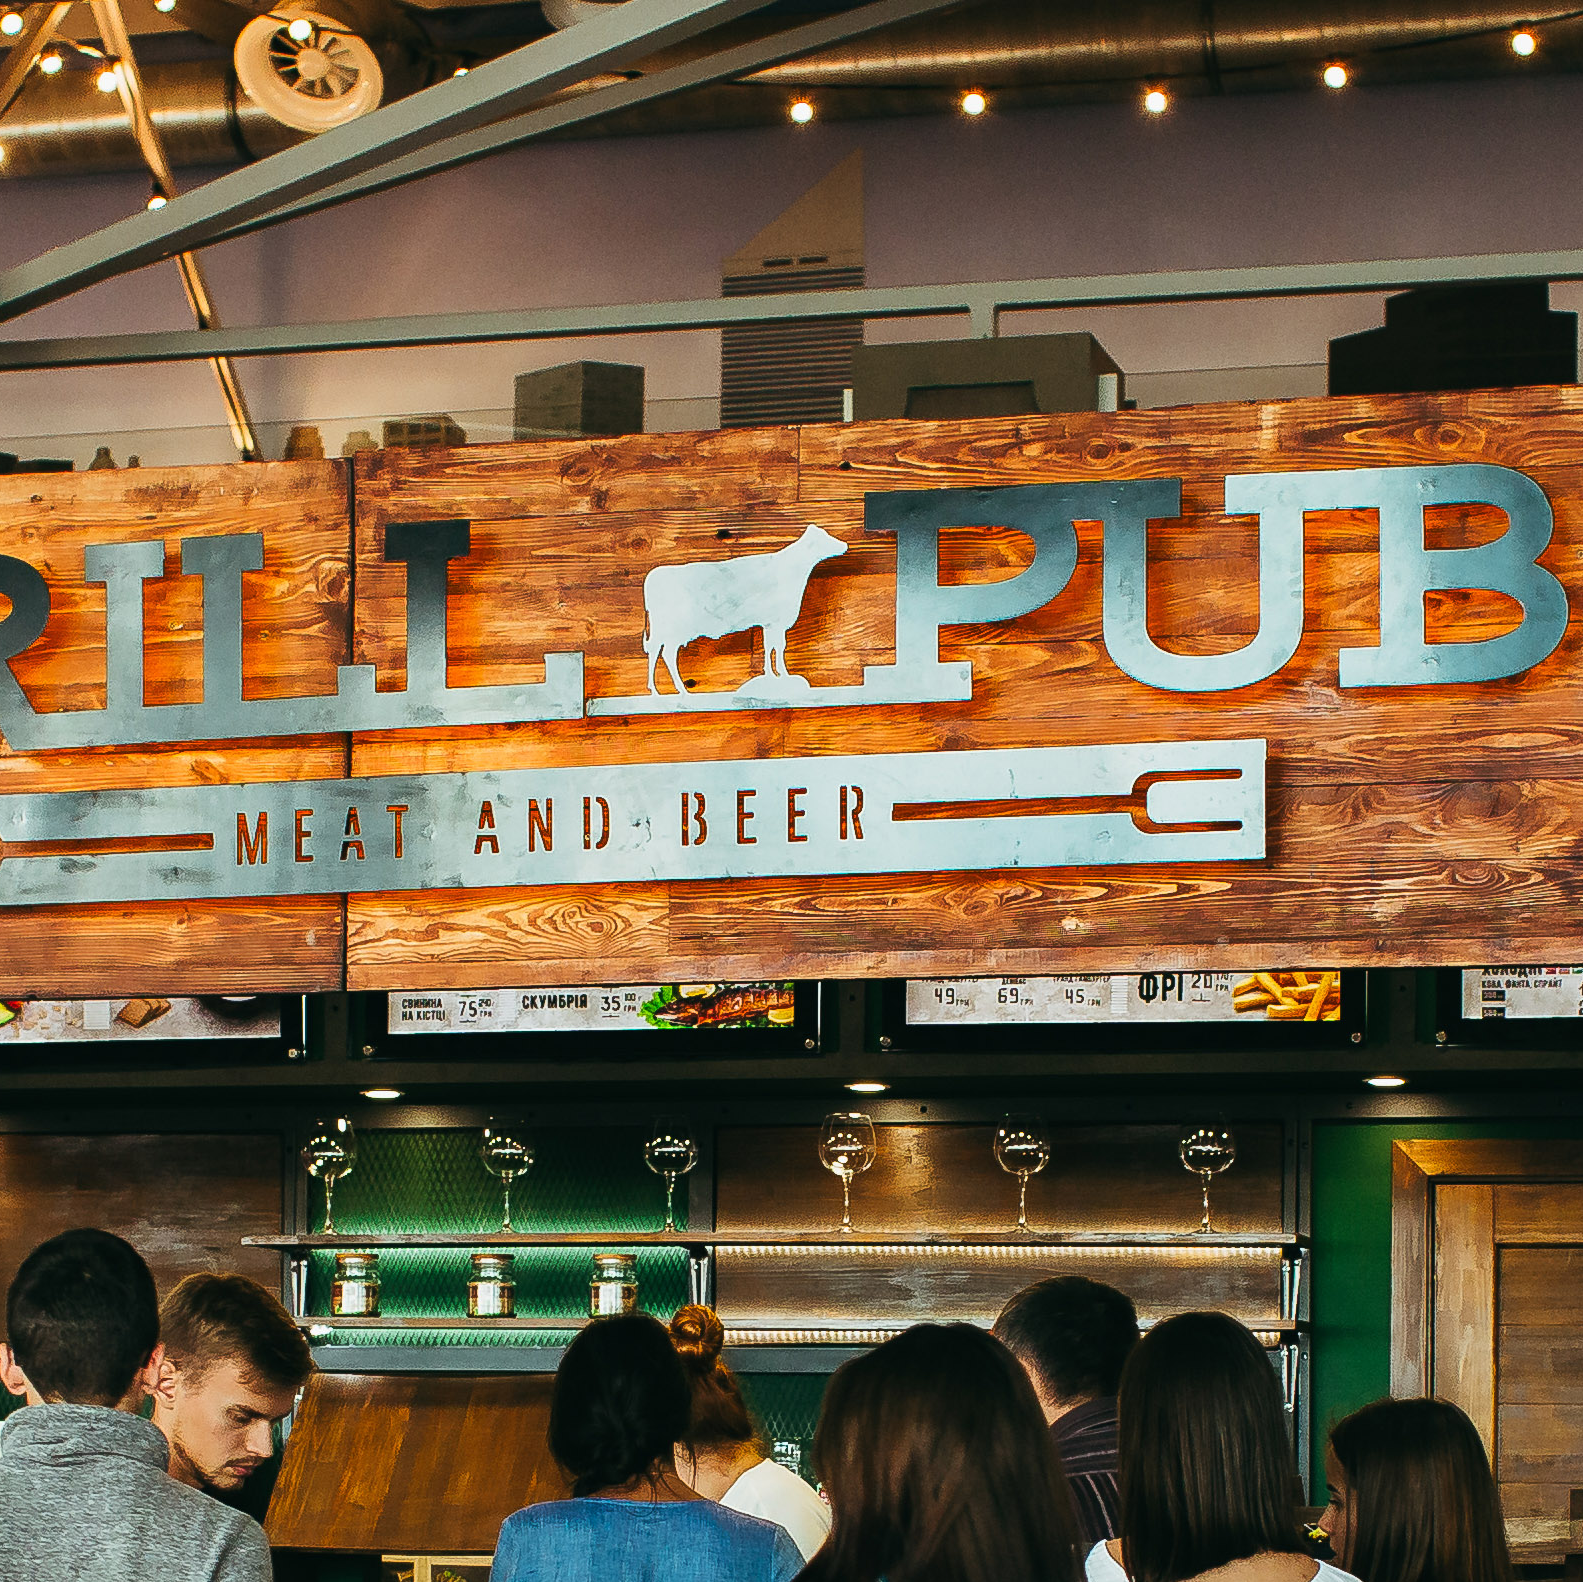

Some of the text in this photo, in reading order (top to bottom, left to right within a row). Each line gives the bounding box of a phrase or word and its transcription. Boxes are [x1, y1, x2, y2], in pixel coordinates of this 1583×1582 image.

[864, 464, 1570, 701] PUB
[236, 785, 864, 865] MEAT AND BEER
[1191, 973, 1213, 989] 20
[521, 994, 588, 1010] СКУМБРІЯ
[600, 995, 621, 1012] 35
[934, 987, 955, 1004] 49
[997, 987, 1019, 1004] 69
[1065, 988, 1085, 1004] 45
[401, 1010, 414, 1021] НА
[458, 1000, 478, 1018] 75
